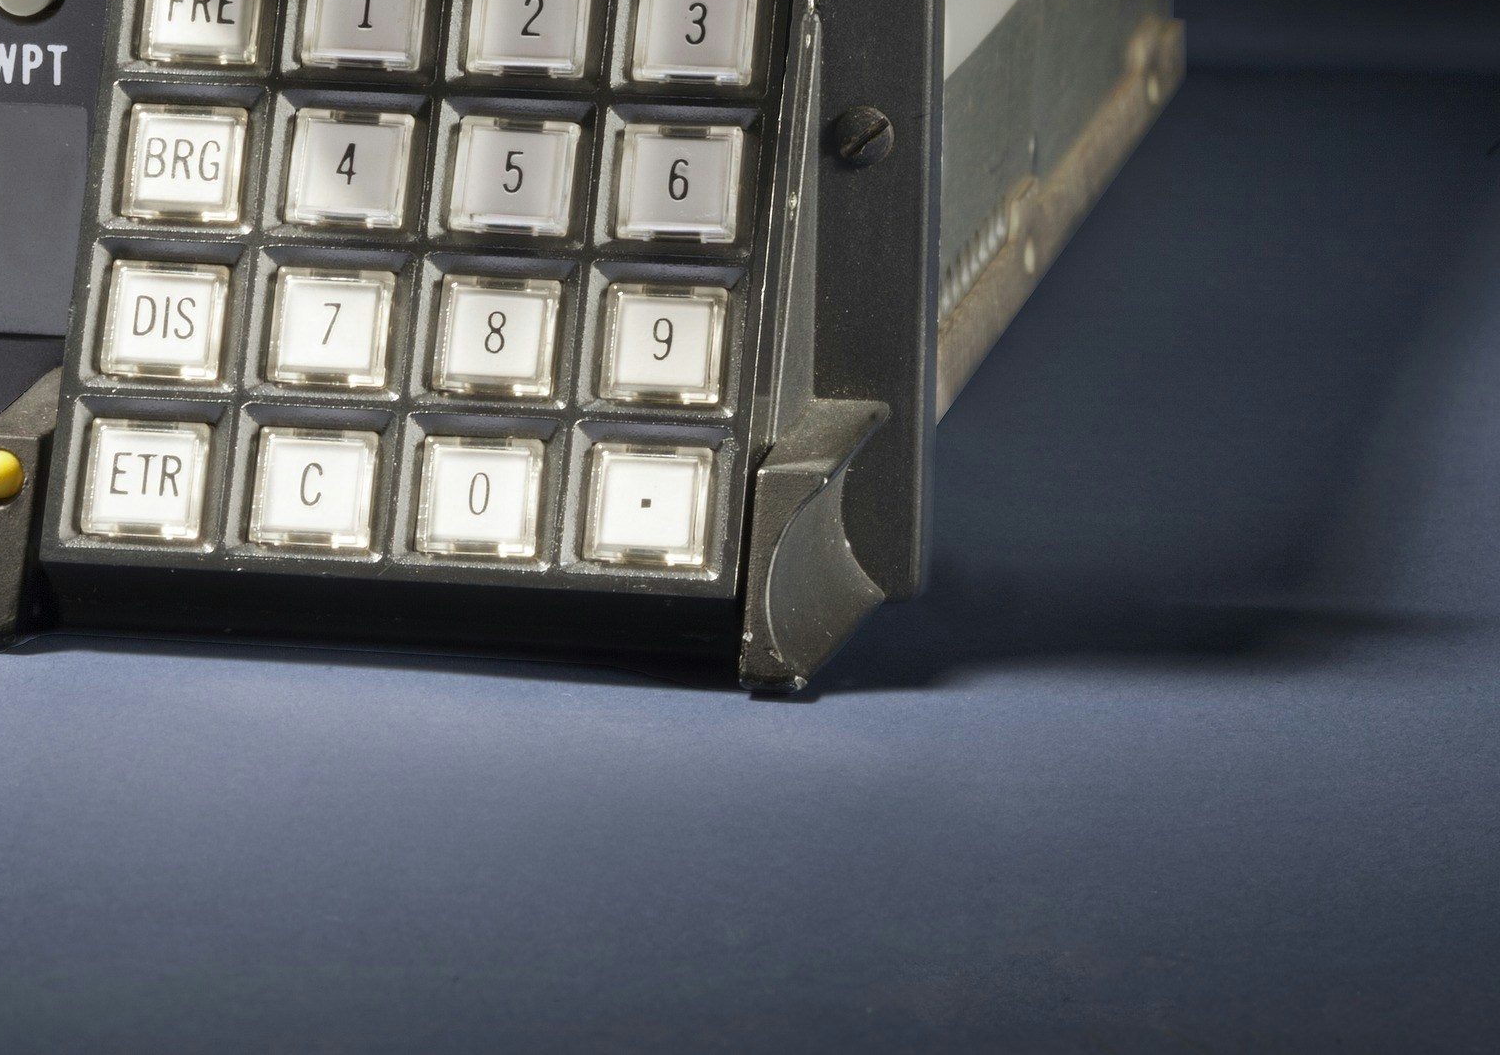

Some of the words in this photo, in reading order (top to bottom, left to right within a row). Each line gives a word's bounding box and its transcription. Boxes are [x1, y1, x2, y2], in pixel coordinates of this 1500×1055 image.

[684, 2, 708, 45] 3
[143, 137, 221, 182] BRG
[336, 142, 357, 185] 4
[502, 150, 524, 194] 5
[668, 158, 689, 201] 6
[132, 295, 196, 340] DIS
[321, 302, 342, 345] 7
[484, 310, 507, 354] 8
[652, 317, 674, 361] 9
[109, 452, 182, 497] ETR
[300, 462, 324, 507] C
[468, 472, 491, 516] 0
